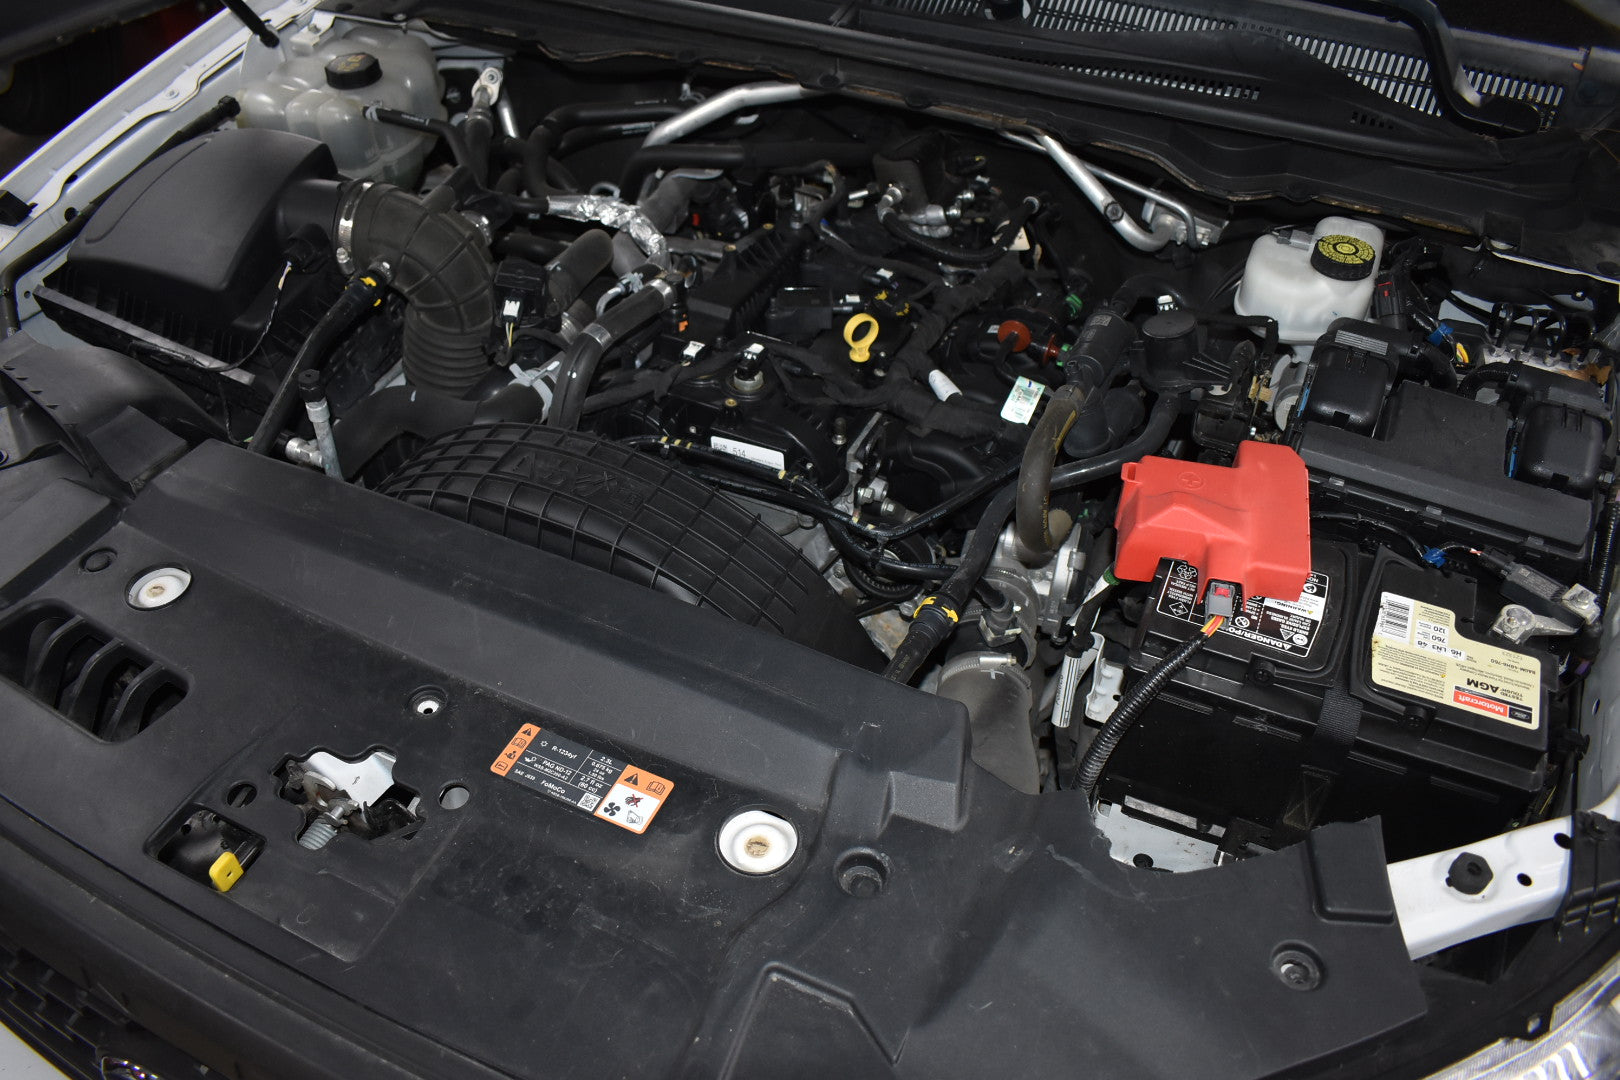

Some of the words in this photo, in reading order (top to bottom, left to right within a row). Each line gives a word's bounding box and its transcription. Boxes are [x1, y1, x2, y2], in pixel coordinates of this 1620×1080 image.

[1433, 626, 1445, 634] 120
[1227, 627, 1283, 648] DANGER/PO
[1431, 635, 1445, 643] 760
[1432, 644, 1447, 652] LN3
[1450, 649, 1462, 657] H6
[1467, 678, 1499, 693] AGM
[1458, 694, 1504, 713] Motorcraft
[551, 745, 577, 759] R-1234yf
[600, 756, 612, 765] 2.3L
[542, 760, 555, 769] PAG
[554, 765, 572, 776] ND-12
[540, 780, 566, 794] FoMoCo
